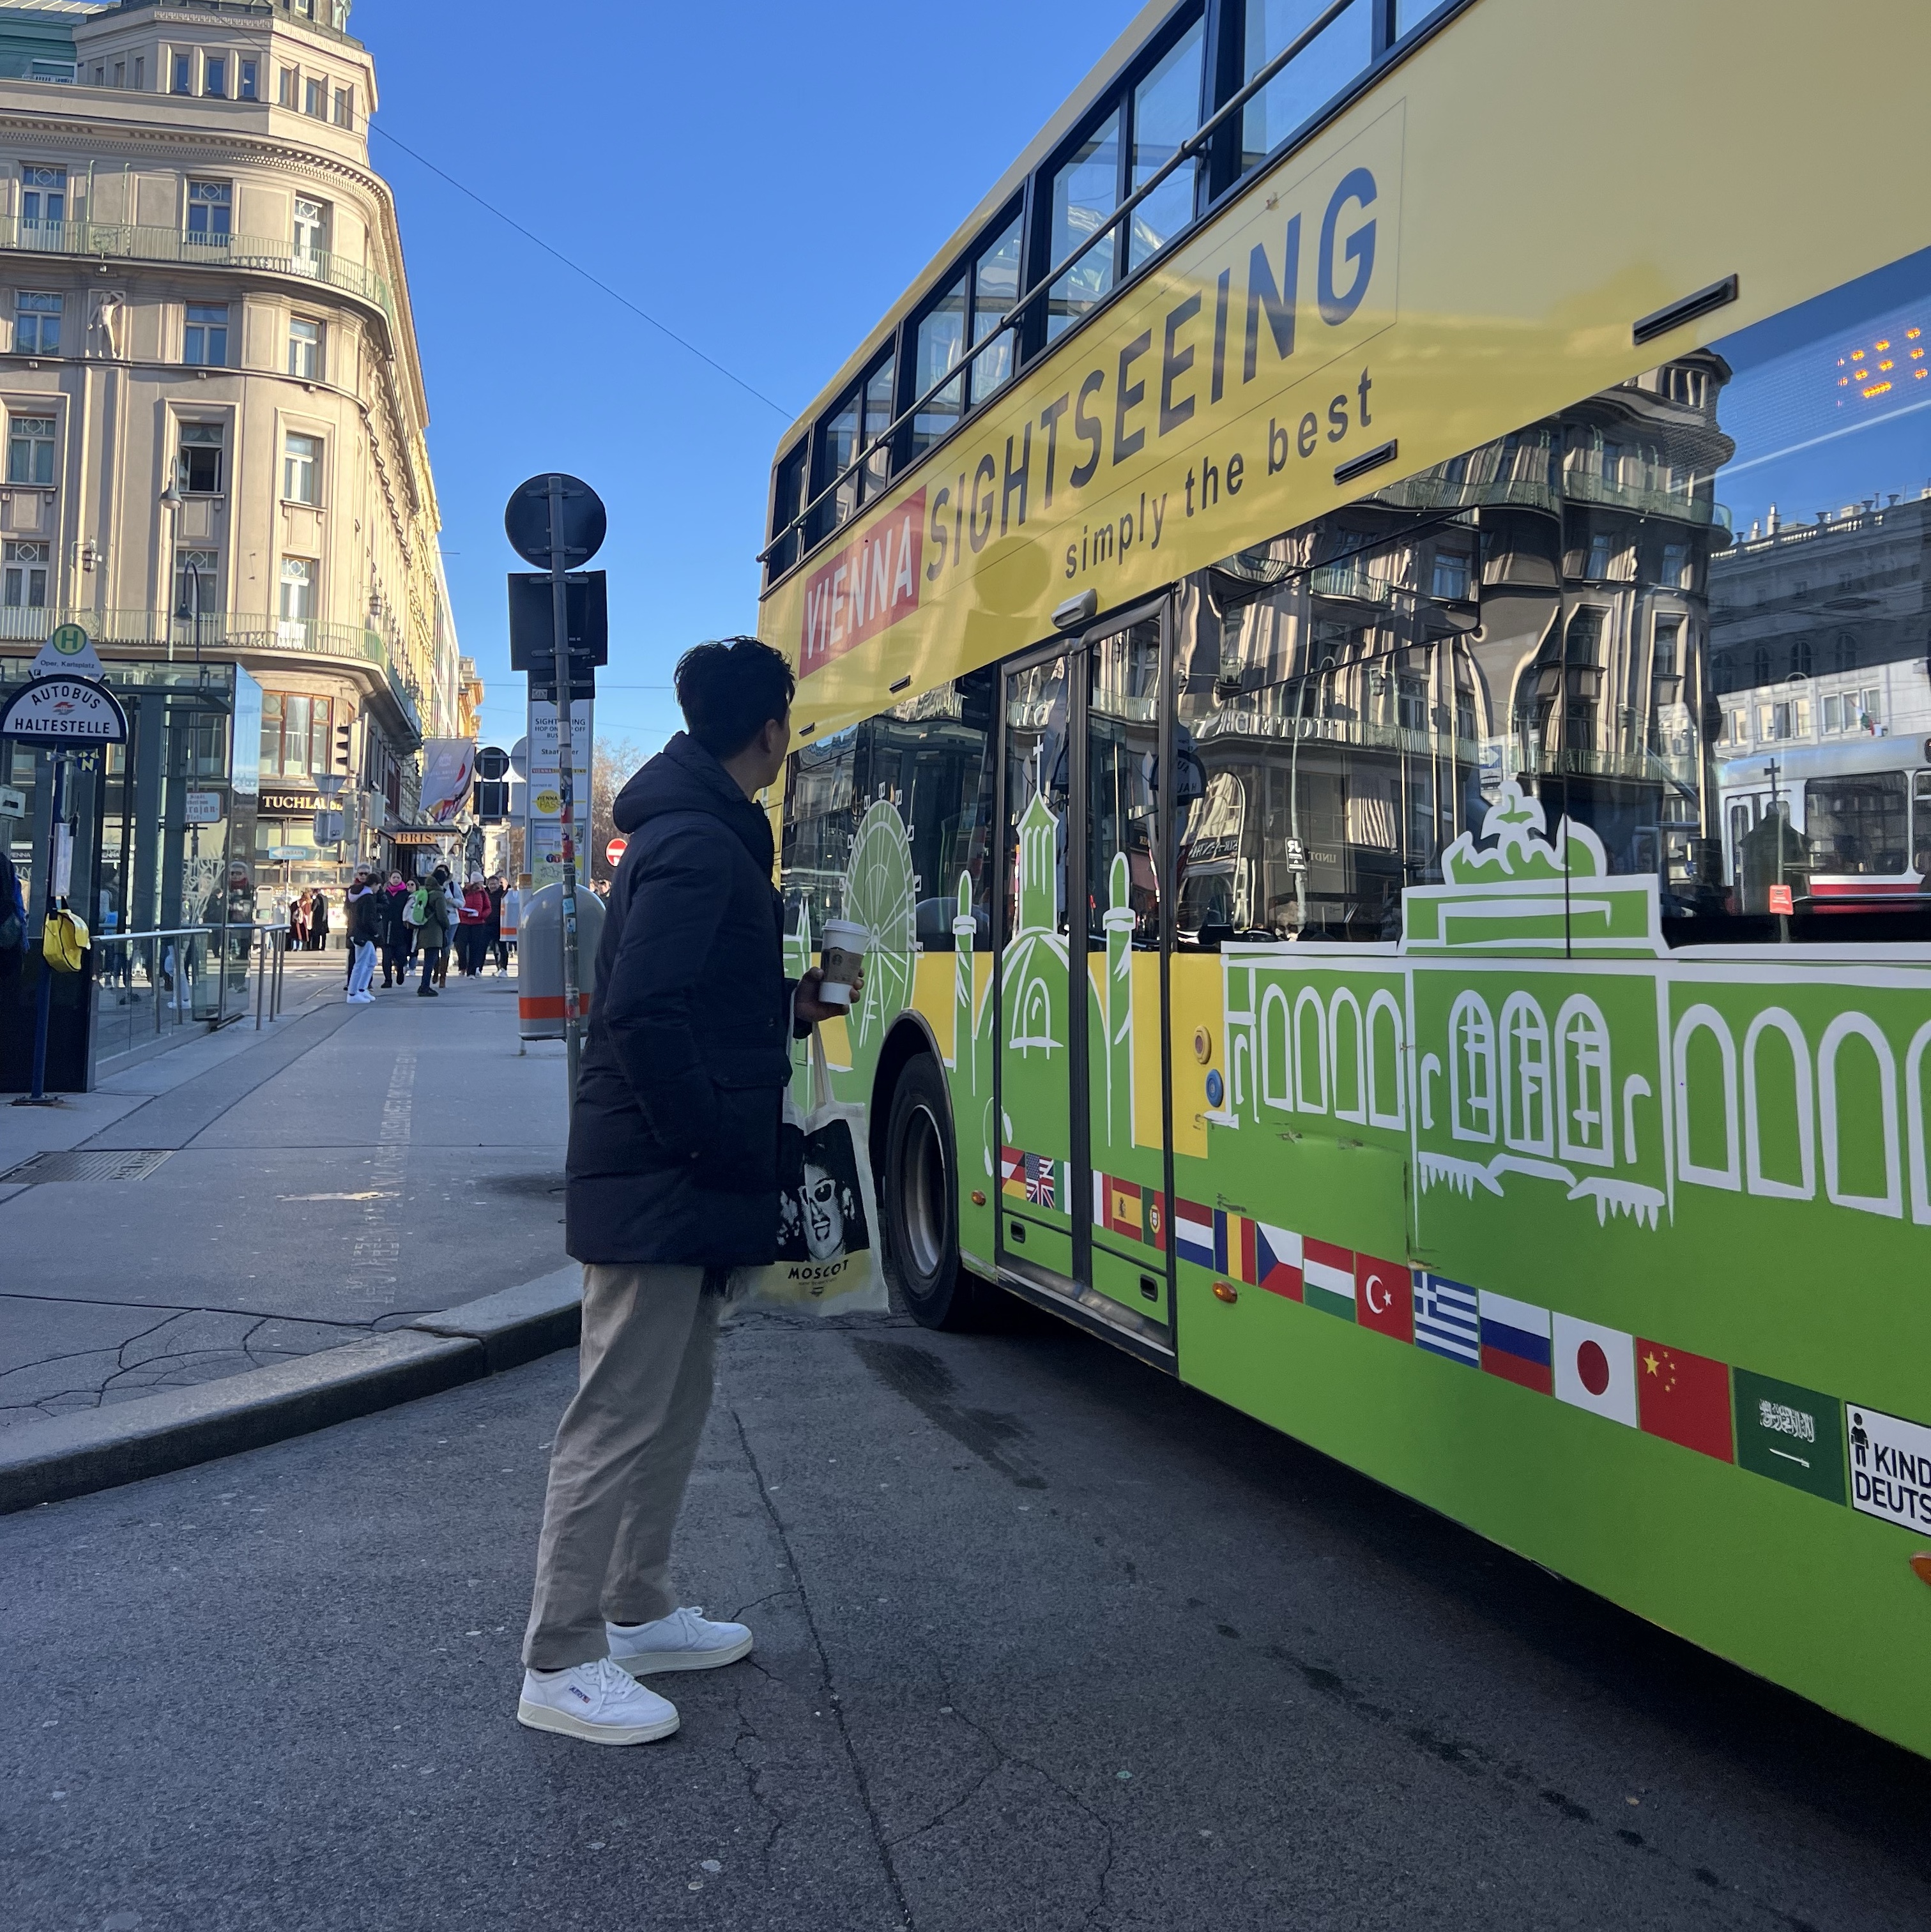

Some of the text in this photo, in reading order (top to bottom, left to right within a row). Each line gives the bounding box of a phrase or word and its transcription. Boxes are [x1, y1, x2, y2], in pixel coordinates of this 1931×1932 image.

[807, 167, 1378, 660] VIENNA SIGHTSEEING
[1065, 365, 1373, 579] simply the best
[61, 630, 79, 650] H
[61, 661, 95, 669] Karlsplatz
[31, 685, 100, 710] AUTOBUS
[15, 718, 111, 734] HALTESTELLE
[81, 759, 95, 772] N
[788, 1259, 849, 1279] MOSCOT
